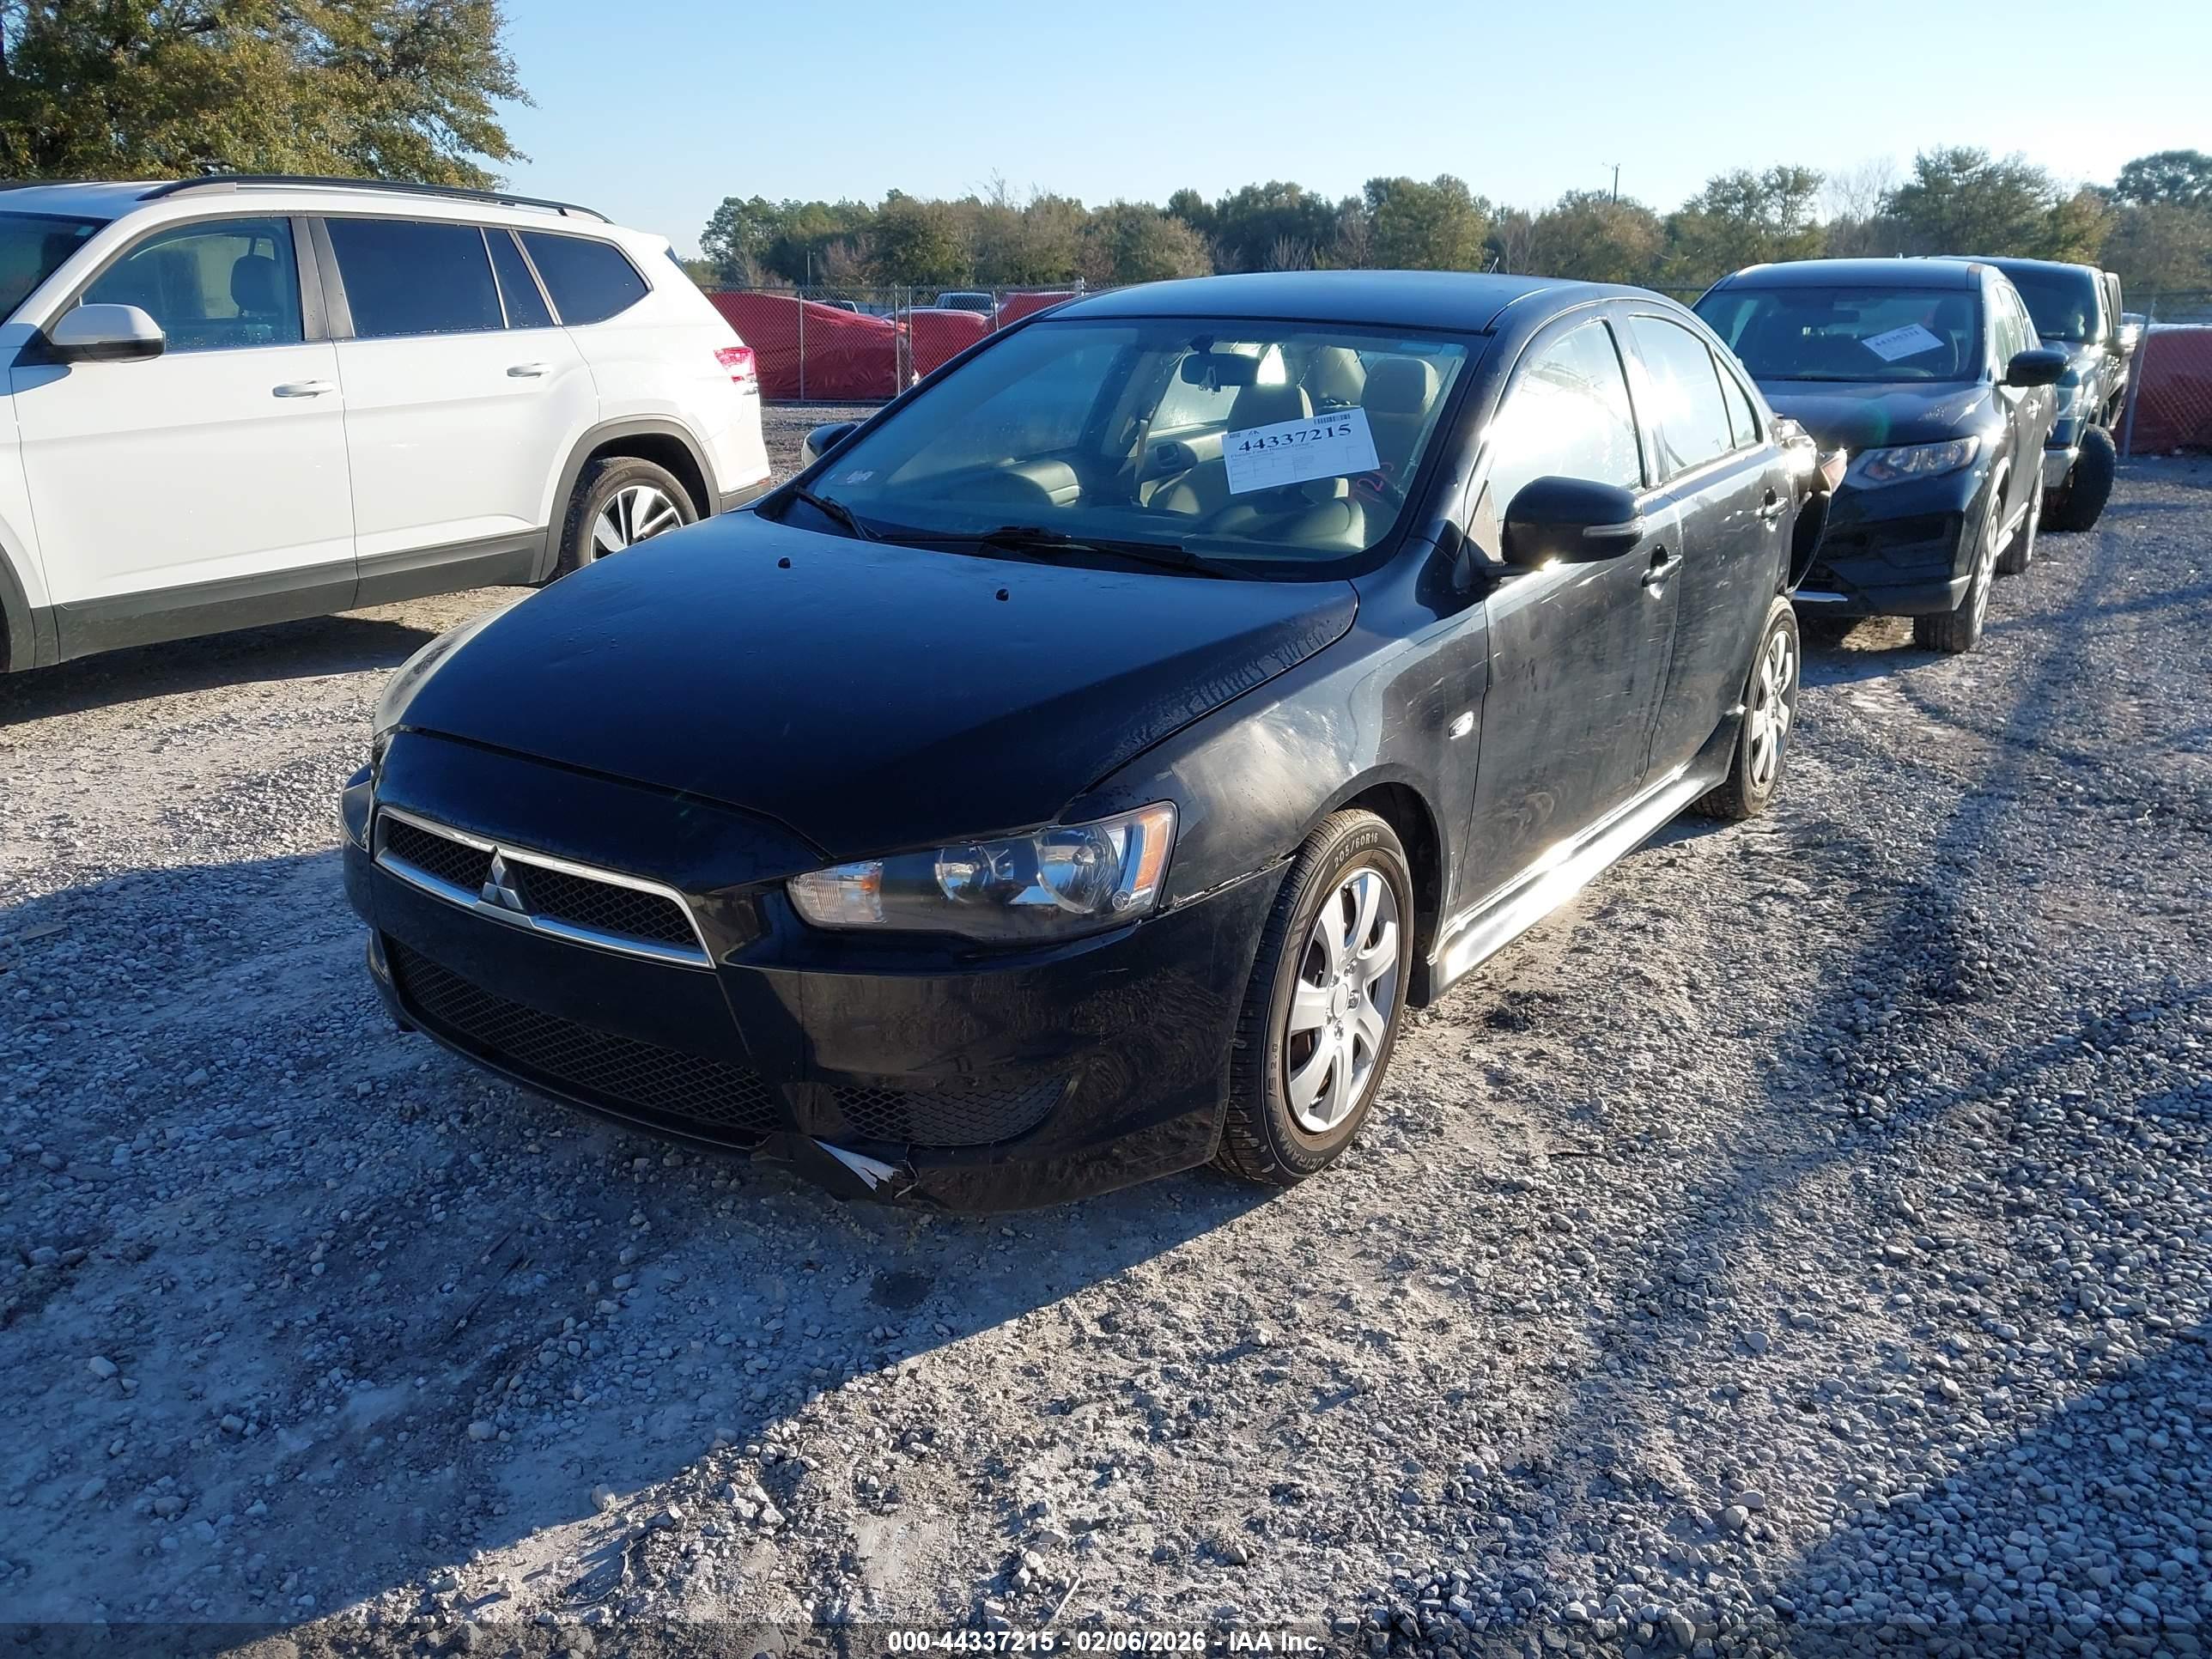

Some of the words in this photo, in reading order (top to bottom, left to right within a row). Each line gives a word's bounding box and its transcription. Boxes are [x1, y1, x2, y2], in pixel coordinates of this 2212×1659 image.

[1238, 423, 1352, 452] 44337215
[1334, 832, 1379, 869] 205/60R16
[1273, 1120, 1326, 1172] ULTRAMAX
